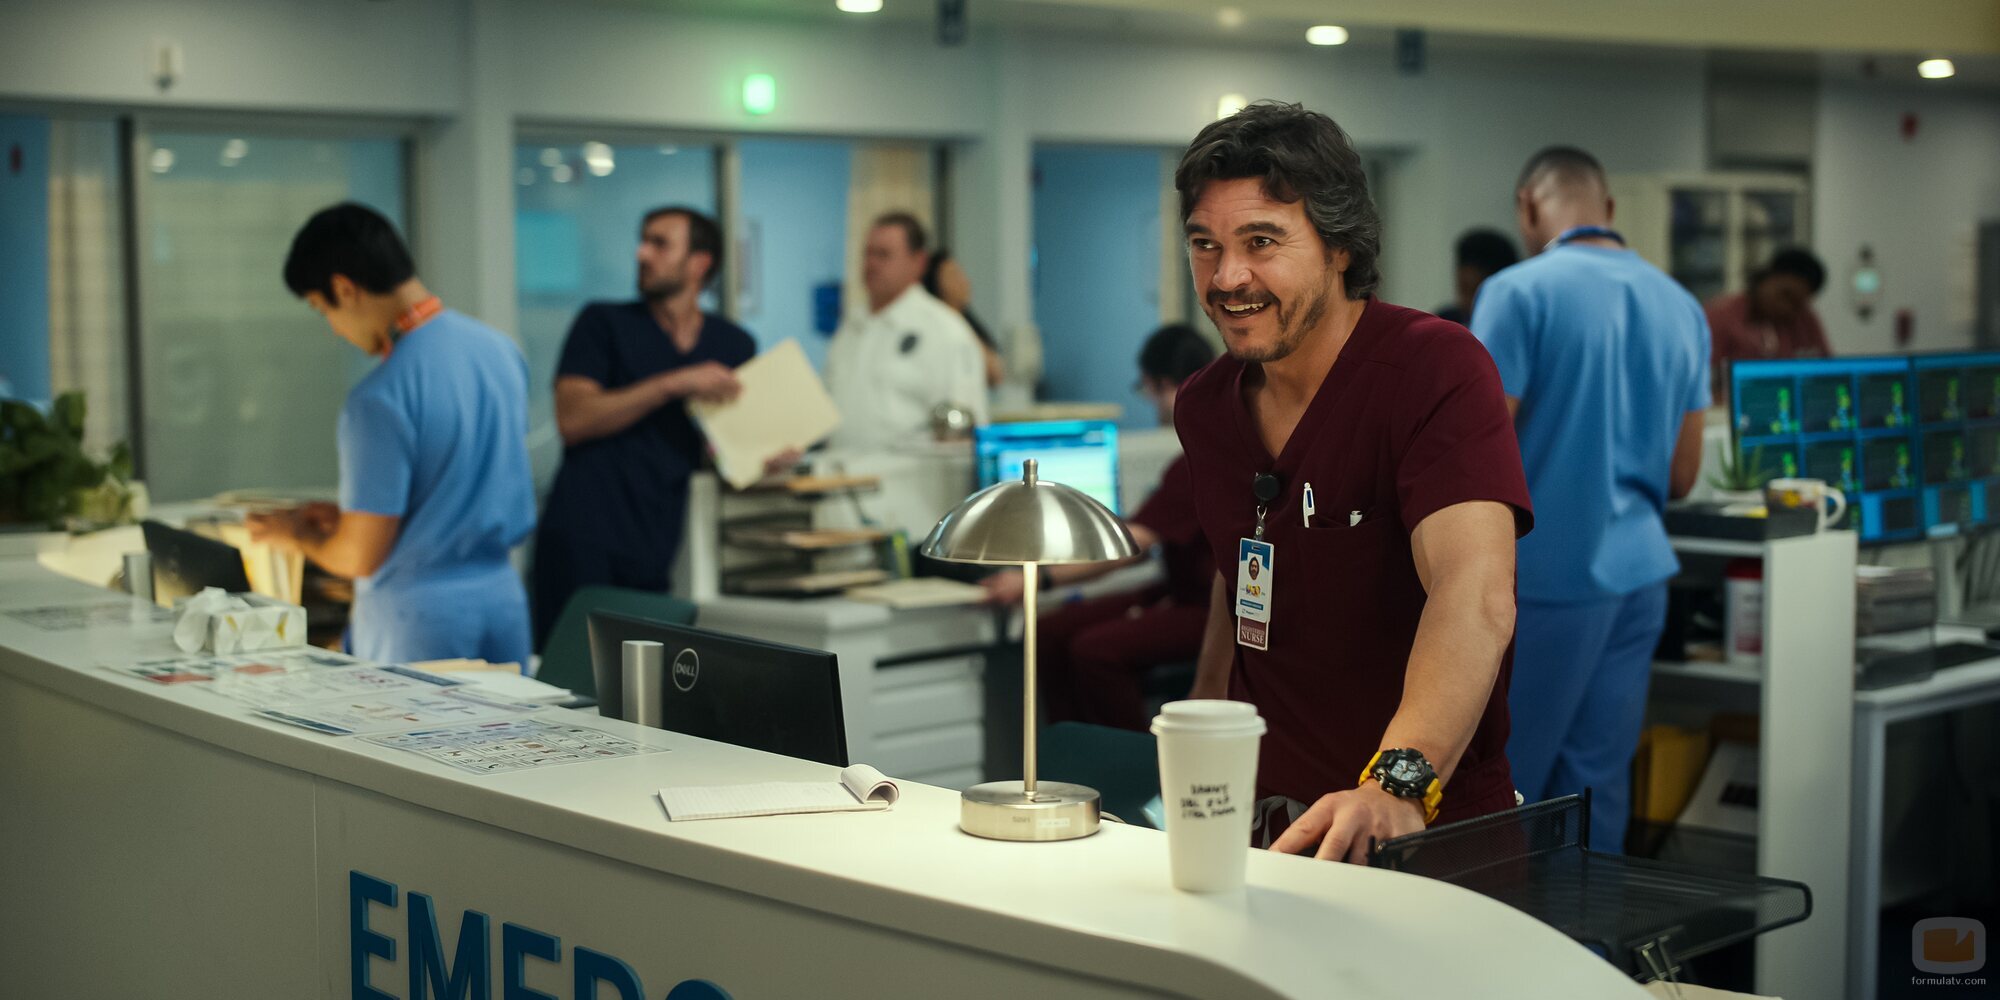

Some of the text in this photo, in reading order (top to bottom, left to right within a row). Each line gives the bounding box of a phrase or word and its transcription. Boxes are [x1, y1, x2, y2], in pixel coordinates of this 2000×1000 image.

[1241, 630, 1265, 644] NURSE
[676, 662, 696, 677] DELL
[349, 869, 736, 1000] EME
